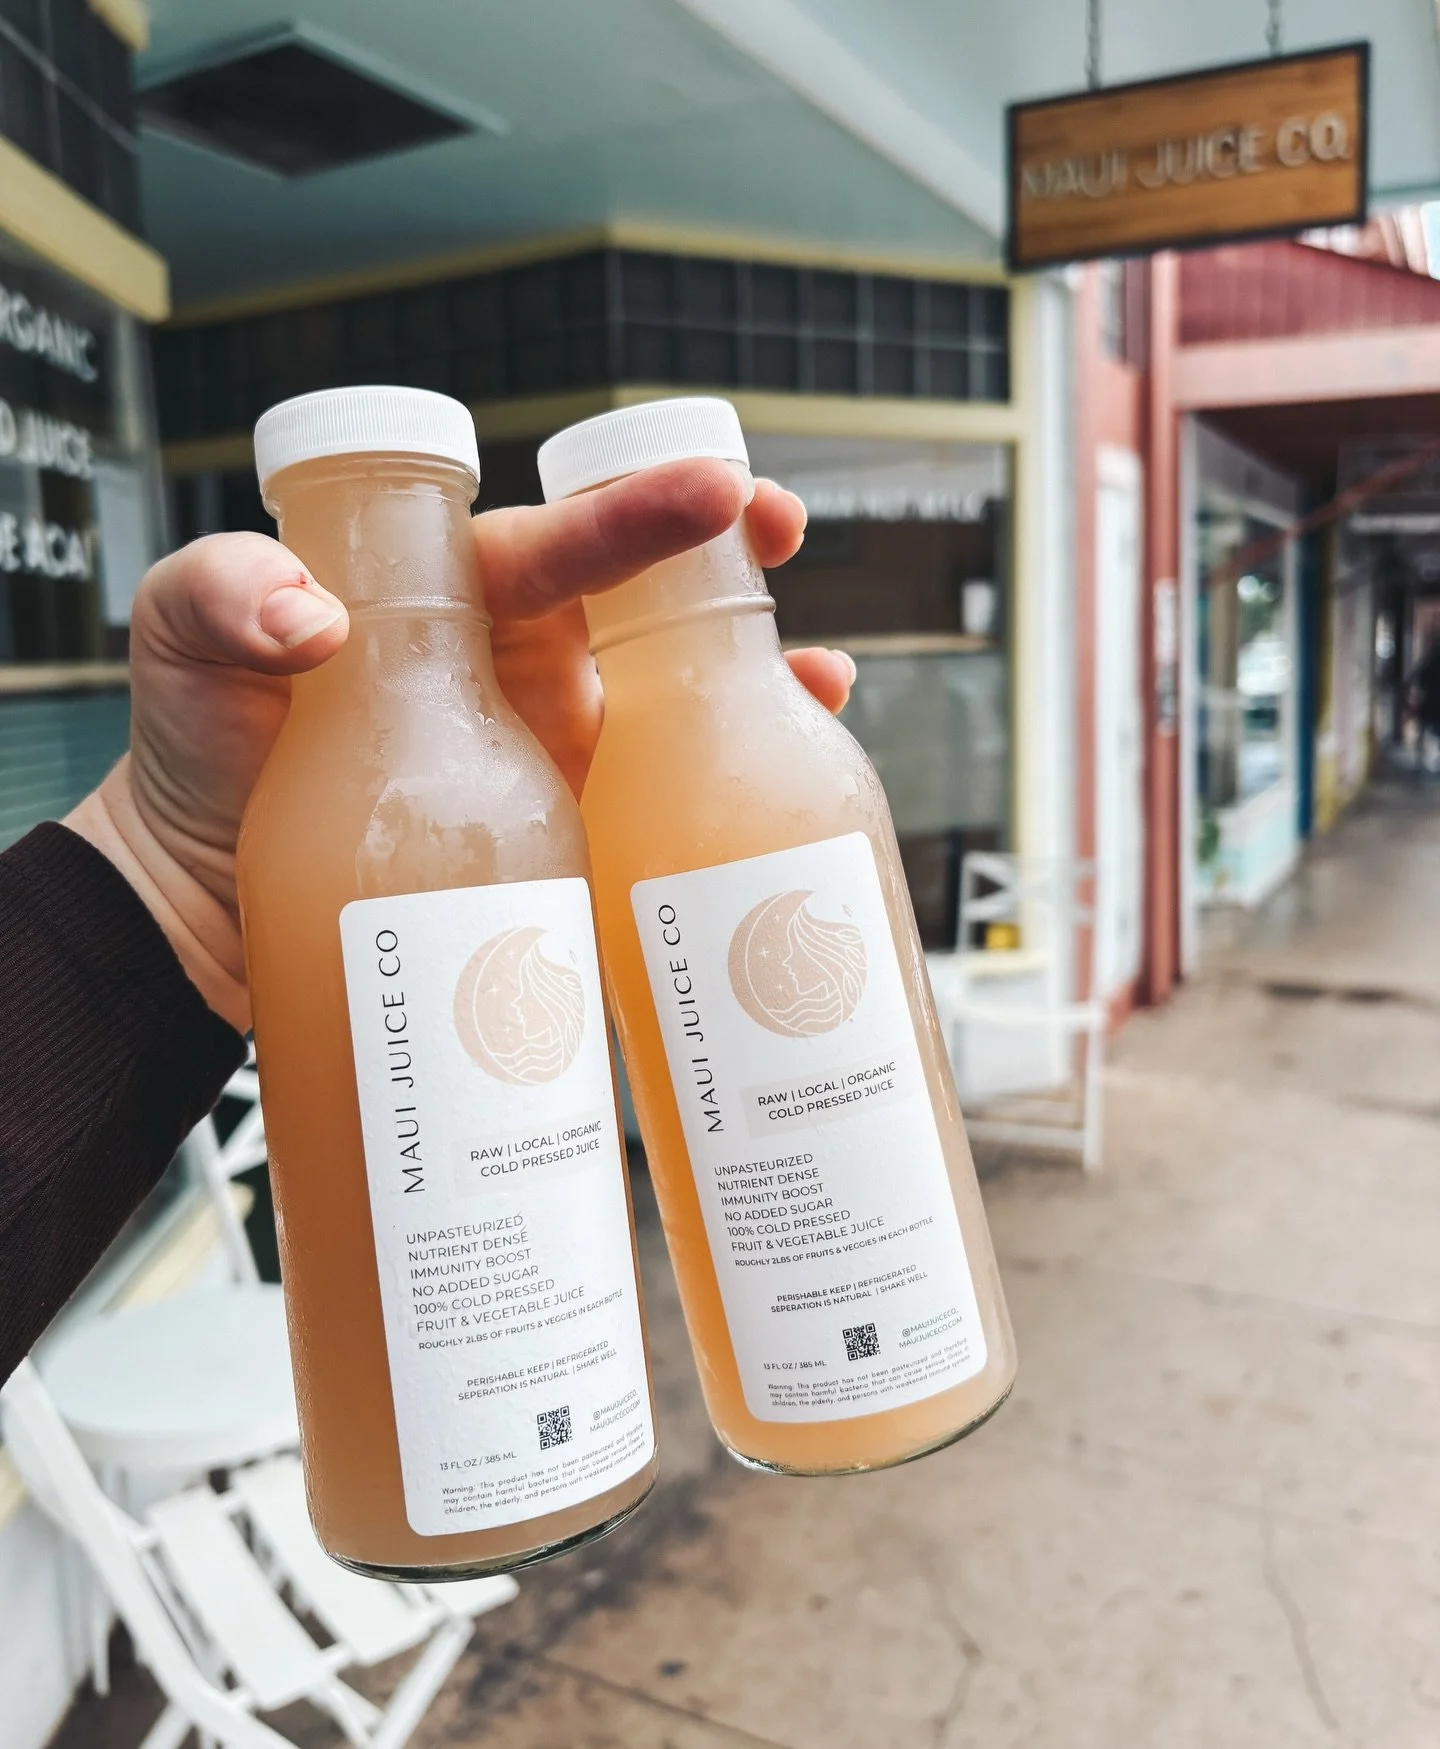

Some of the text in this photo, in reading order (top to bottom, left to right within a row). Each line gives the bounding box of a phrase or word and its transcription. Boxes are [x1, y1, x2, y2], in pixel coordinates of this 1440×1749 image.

[1021, 152, 1127, 199] MAUI
[1135, 126, 1265, 188] JUICE
[658, 904, 724, 1132] MAUI JUICE CO
[375, 929, 425, 1194] MAUI JUICE CO
[758, 1061, 896, 1106] RAW LOCAL ORGANIC
[768, 1079, 894, 1120] COLD PRESSED JUICE
[471, 1121, 601, 1161] RAW LOCAL ORGANIC
[481, 1139, 599, 1177] COLD PRESSED JUICE
[714, 1153, 813, 1176] UNPASTEURIZED
[718, 1168, 820, 1191] NUTRIENT DENSE
[721, 1183, 824, 1206] IMMUNITY BOOST
[724, 1198, 833, 1221] NO ADDED SUGAR
[406, 1215, 523, 1244] UNPASTEURIZED
[727, 1210, 850, 1236] 100% COLD PRESSED
[731, 1216, 885, 1251] FRUIT & VEGETABLE JUICE
[735, 1258, 770, 1266] ROUGHLY
[772, 1256, 791, 1264] 2LBS
[806, 1249, 834, 1260] FRUITS
[843, 1238, 877, 1251] VEGGIES
[879, 1234, 887, 1244] IN
[888, 1227, 908, 1240] EACH
[909, 1216, 934, 1232] BOTTLE
[409, 1231, 529, 1261] NUTRIENT DENSE
[411, 1248, 531, 1279] IMMUNITY BOOST
[413, 1265, 539, 1297] NO ADDED SUGAR
[413, 1279, 554, 1314] 100% COLD PRESSED
[771, 1272, 927, 1312] SEPERATION IS NATURAL SHAKE WELL
[777, 1265, 917, 1302] PERISHABLE KEEP REFRIGERATED
[417, 1286, 585, 1332] FRUIT & VEGETABLE JUICE
[419, 1338, 463, 1350] ROUGHLY
[466, 1333, 488, 1344] 2LBS
[490, 1329, 502, 1339] OF
[505, 1323, 535, 1336] FRUITS
[544, 1311, 577, 1326] VEGGIES
[579, 1306, 586, 1315] IN
[586, 1300, 604, 1313] EACH
[604, 1288, 623, 1304] BOTTLE
[458, 1349, 617, 1400] SEPERATION IS NATURAL SHAKE WELL
[467, 1340, 608, 1387] PERISHABLE KEEP REFRIGERATED
[811, 1388, 836, 1396] harmful
[840, 1383, 868, 1393] bacteria
[904, 1367, 922, 1377] cause
[813, 1380, 838, 1389] product
[892, 1356, 928, 1373] pasteurized
[931, 1350, 941, 1358] and
[853, 1391, 878, 1400] persons
[880, 1384, 893, 1393] with
[896, 1374, 927, 1389] weakened
[440, 1451, 517, 1470] 13 FL OZ / 385 ML
[480, 1481, 494, 1489] This
[499, 1474, 527, 1485] product
[562, 1458, 579, 1469] been
[582, 1442, 614, 1462] pasteurized
[444, 1497, 459, 1505] may
[463, 1493, 492, 1501] contain
[496, 1485, 524, 1495] harmful
[529, 1476, 558, 1488] bacteria
[562, 1470, 575, 1478] that
[579, 1464, 590, 1472] can
[445, 1505, 477, 1514] children,
[495, 1496, 522, 1506] elderly,
[541, 1484, 567, 1496] persons
[569, 1476, 582, 1485] with
[584, 1462, 612, 1480] weakened
